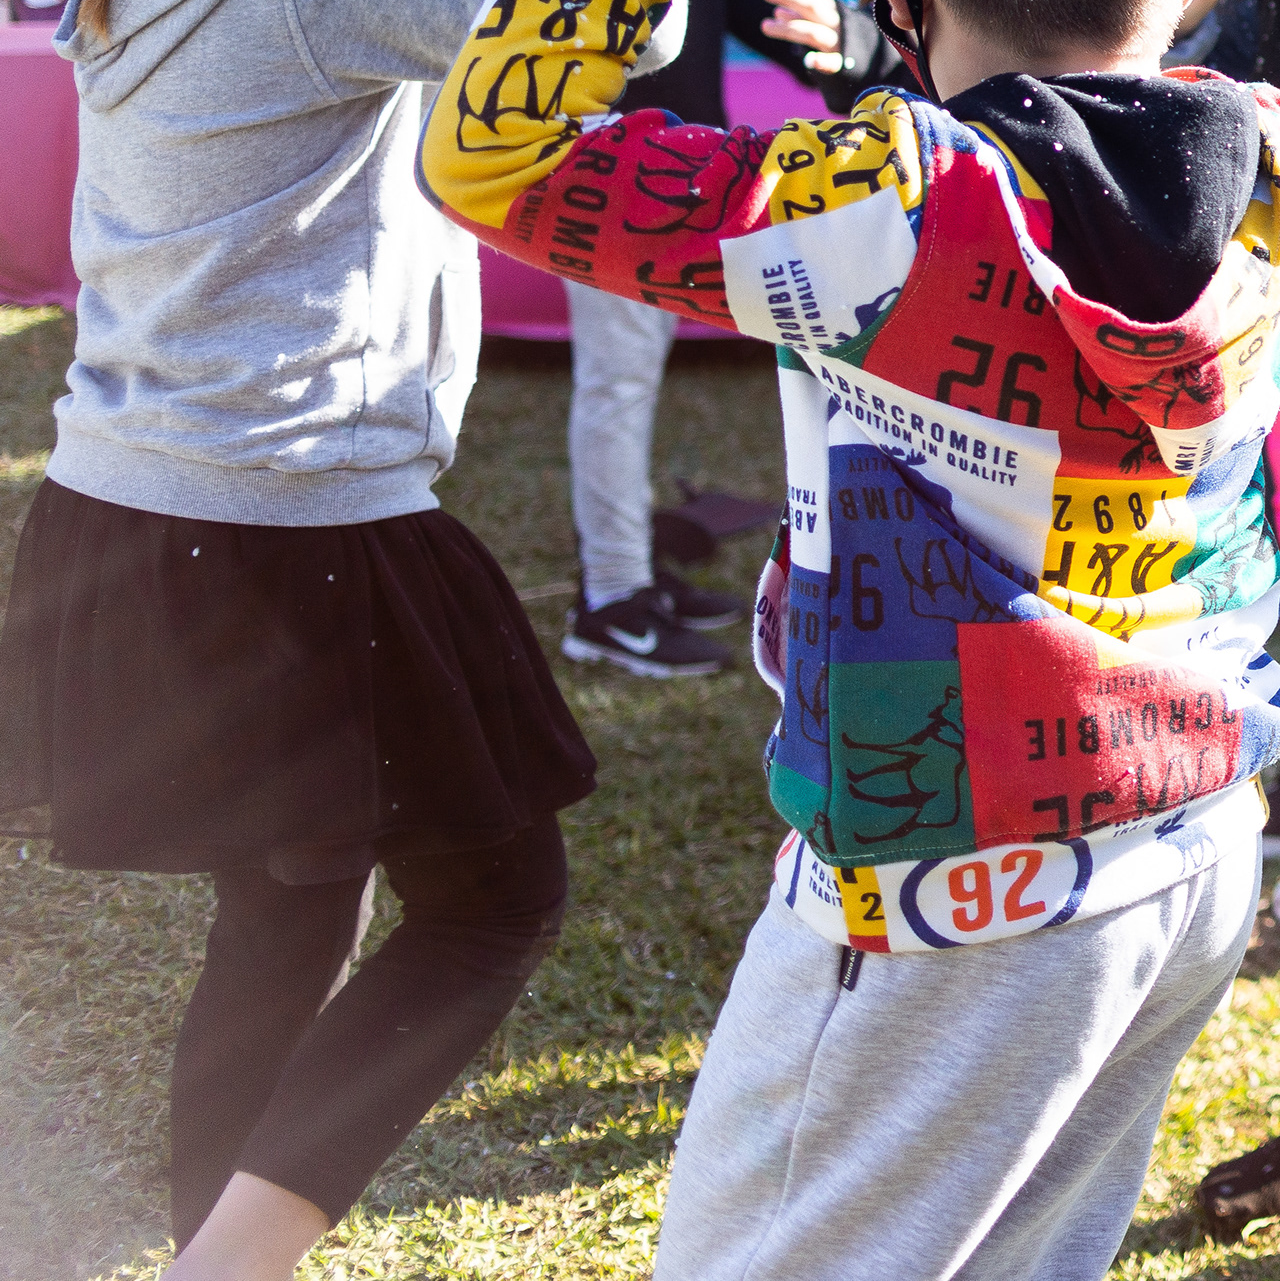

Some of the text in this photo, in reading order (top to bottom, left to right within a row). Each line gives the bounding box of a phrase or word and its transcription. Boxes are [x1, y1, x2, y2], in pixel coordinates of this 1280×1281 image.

[787, 259, 820, 320] QUALITY
[820, 363, 1019, 469] ABERCROMBIE
[921, 438, 939, 458] IN
[946, 451, 1018, 487] QUALITY
[947, 848, 1047, 933] 92
